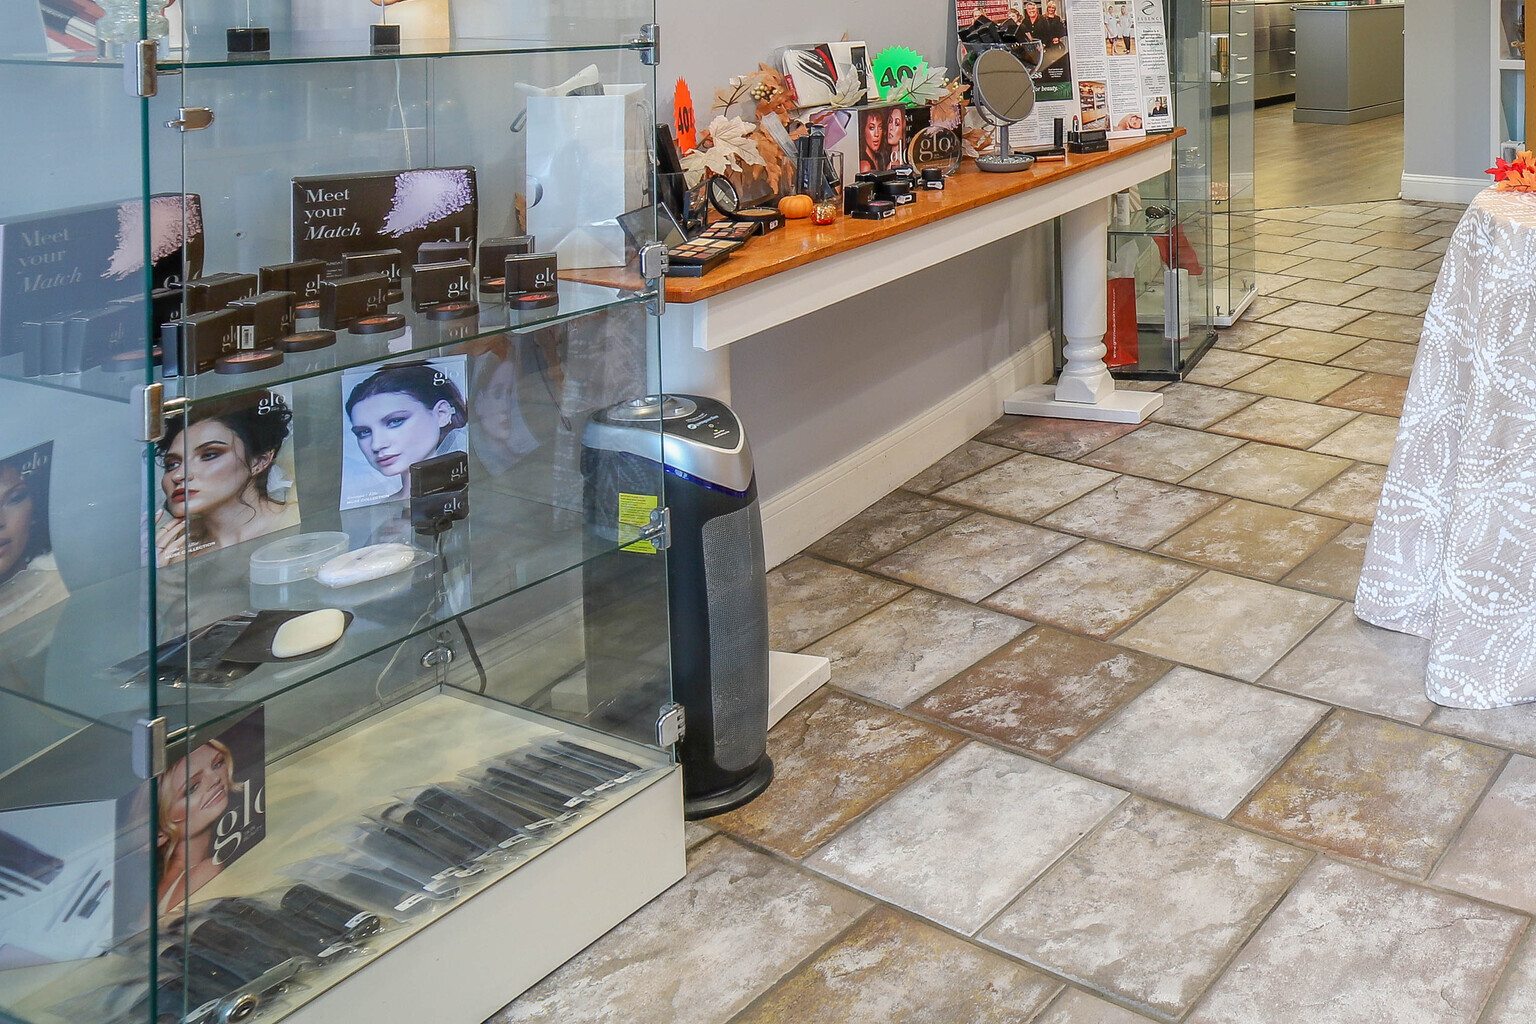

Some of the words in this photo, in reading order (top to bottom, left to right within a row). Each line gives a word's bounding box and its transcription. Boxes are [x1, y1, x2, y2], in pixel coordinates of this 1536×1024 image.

[919, 134, 951, 162] glo
[305, 187, 350, 204] Meet
[304, 207, 346, 224] your
[22, 228, 69, 248] Meet
[304, 223, 361, 241] Match
[17, 250, 66, 274] your
[18, 267, 82, 294] Match
[258, 391, 286, 415] glo
[360, 494, 390, 503] COLLECTION
[181, 541, 216, 554] CLLECTION
